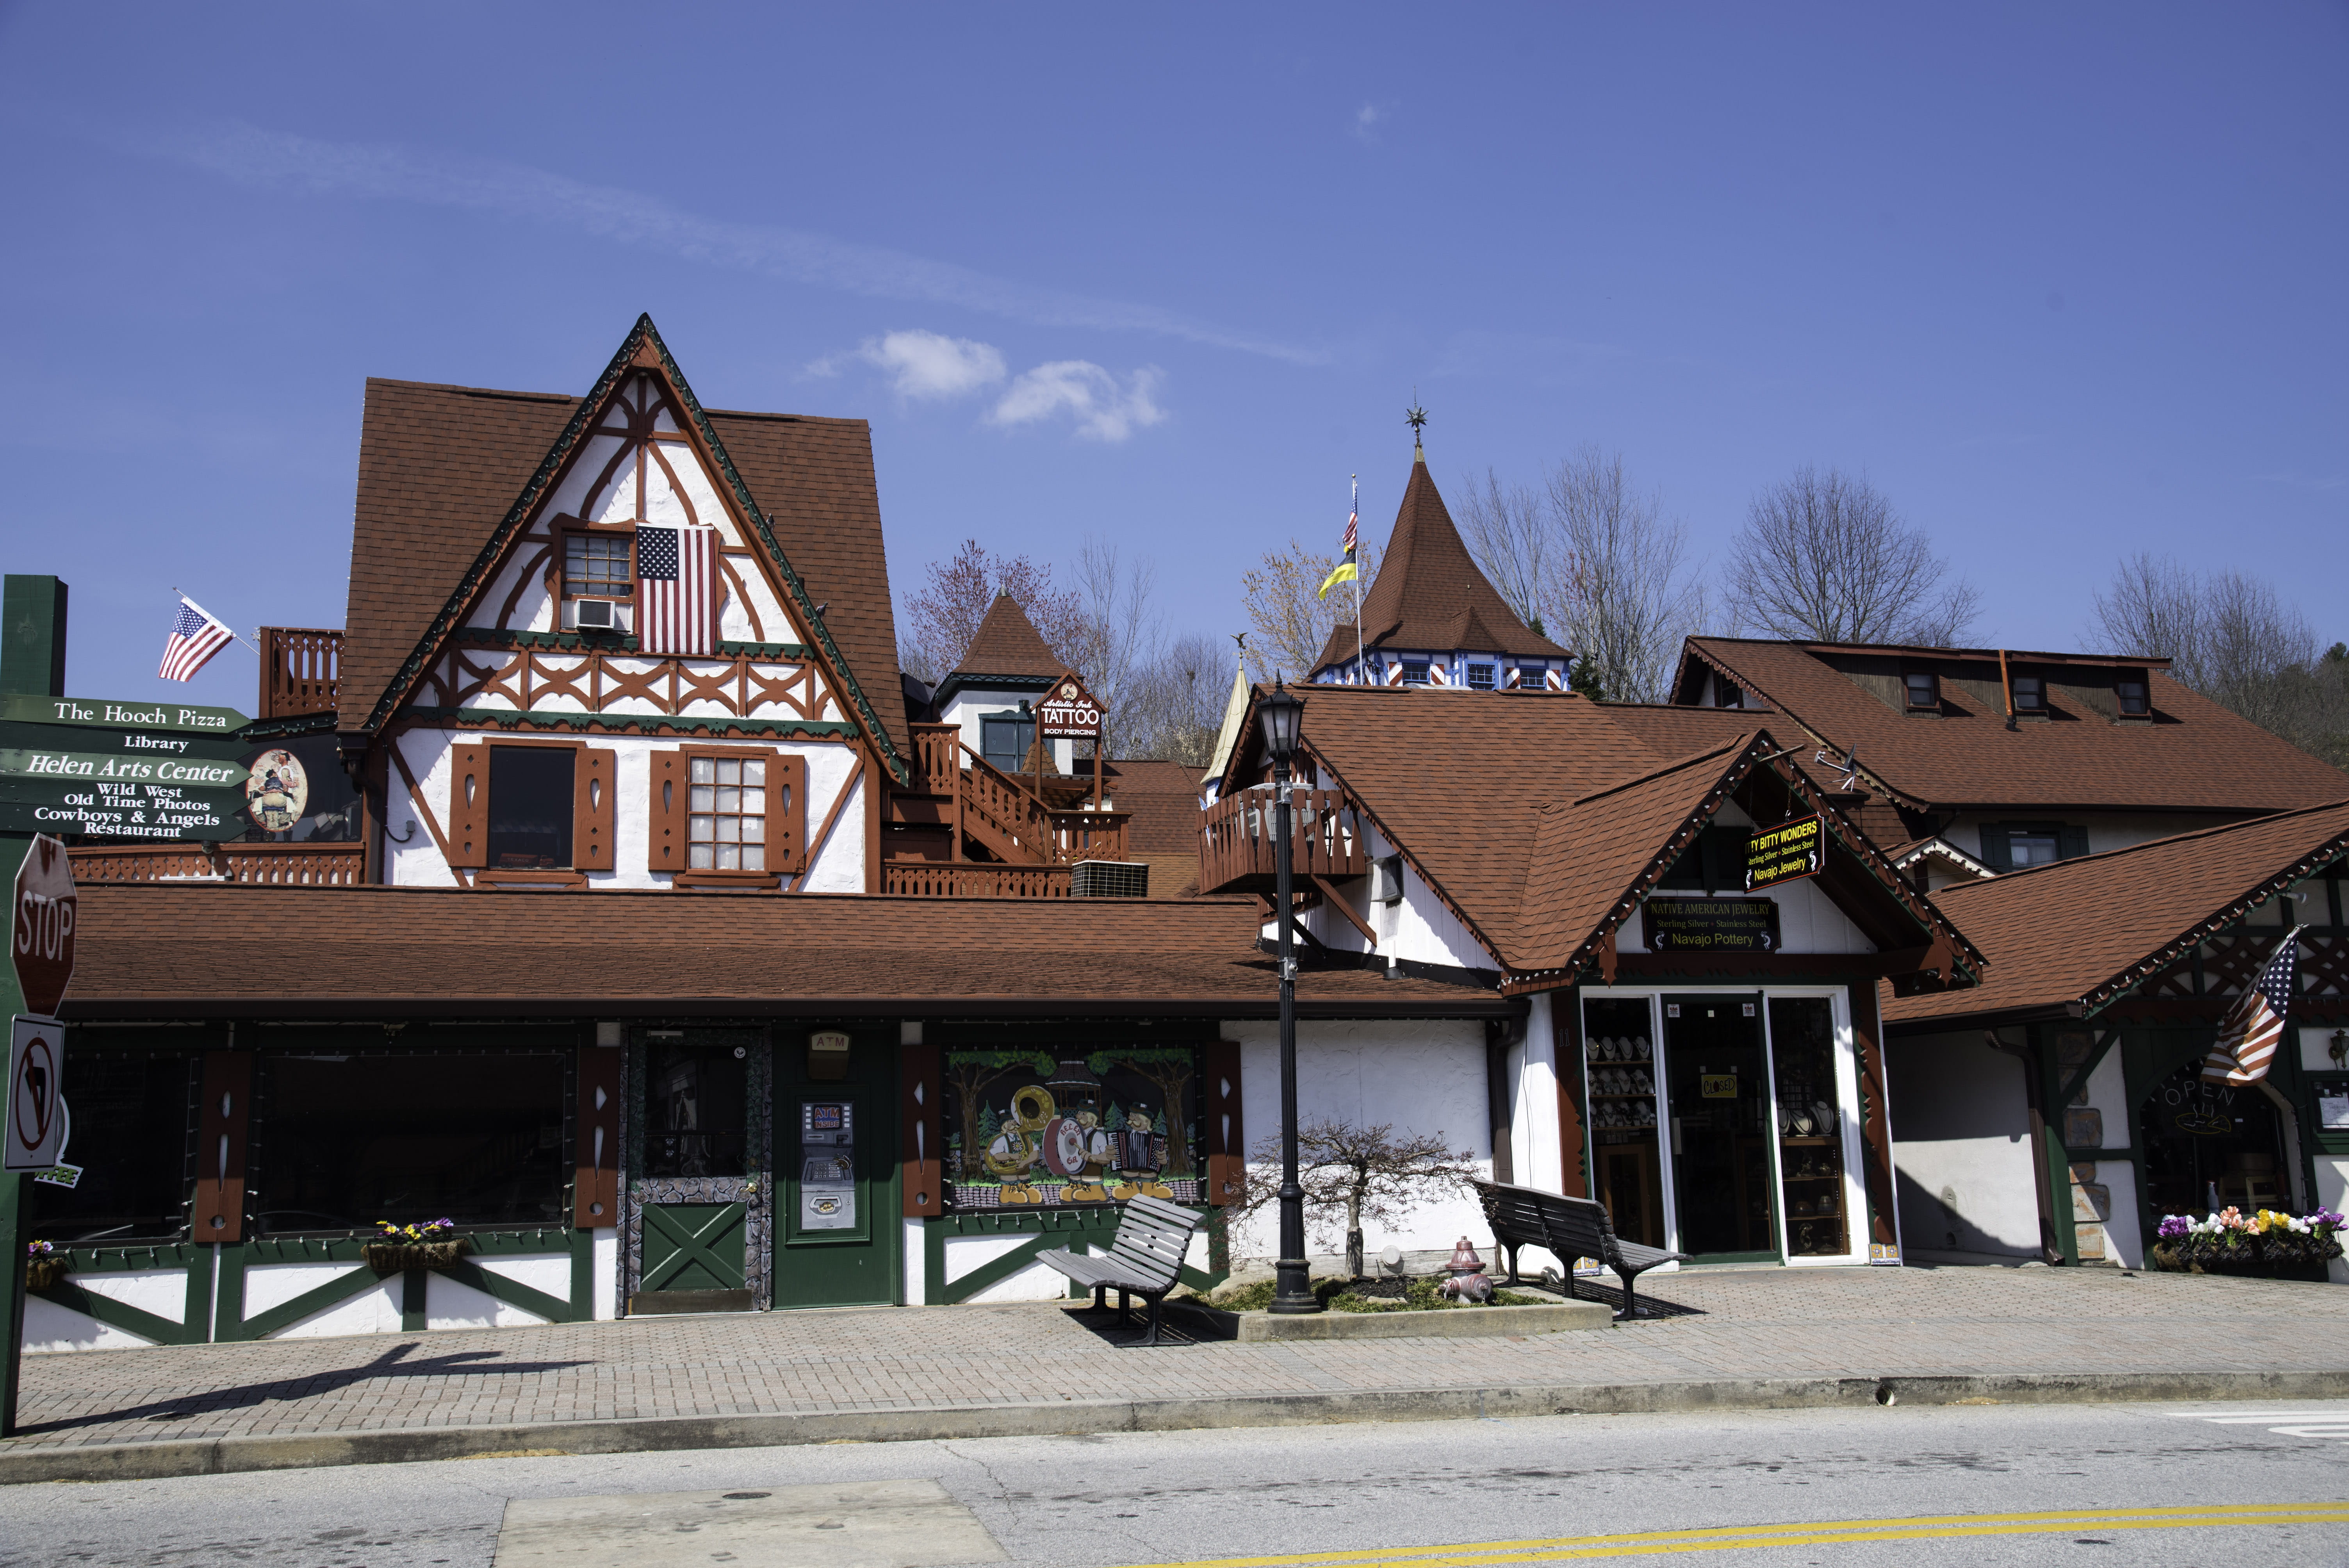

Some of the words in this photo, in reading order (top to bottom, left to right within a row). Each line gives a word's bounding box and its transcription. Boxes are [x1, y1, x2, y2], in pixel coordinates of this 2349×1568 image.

[1044, 699, 1074, 707] Artistic
[54, 703, 94, 720] The
[104, 705, 166, 723] Hooch
[177, 709, 226, 727] Pizza
[1041, 707, 1099, 725] TATTOO
[124, 736, 189, 753] Library
[26, 755, 94, 775] Helen
[98, 759, 152, 778] Arts
[157, 762, 234, 782] Center
[96, 783, 135, 795] Wild
[144, 786, 182, 798] West
[64, 794, 94, 805] Old
[102, 796, 146, 807] Time
[153, 798, 210, 811] Photos
[34, 807, 122, 825] Cowboys
[131, 811, 146, 823] &
[155, 812, 220, 828] Angels
[84, 822, 182, 837] Restaurant
[1745, 839, 1759, 855] ITTY
[1760, 832, 1779, 850] BITTY
[1780, 820, 1817, 843] WONDERS
[1748, 855, 1764, 866] Sterling
[1764, 851, 1778, 861] Silver
[1782, 844, 1801, 855] Stainless
[1802, 838, 1814, 849] Steel
[1754, 865, 1777, 881] Navajo
[1779, 857, 1806, 874] Jewelry
[1651, 903, 1682, 914] NATIVE
[1685, 903, 1730, 914] AMERICAN
[1731, 903, 1770, 916] JEWELRY
[18, 890, 73, 961] STOP
[1657, 919, 1686, 929] Sterling
[1672, 933, 1711, 947] Navajo
[1715, 934, 1753, 947] Pottery
[816, 1037, 844, 1047] ATM
[1559, 1028, 1570, 1047] 11
[1704, 1078, 1735, 1094] CLOSED
[2165, 1081, 2235, 1106] OPEN
[814, 1106, 840, 1119] ATM
[814, 1120, 840, 1128] INSIDE
[1060, 1123, 1081, 1136] HELEN
[1066, 1156, 1078, 1165] GA
